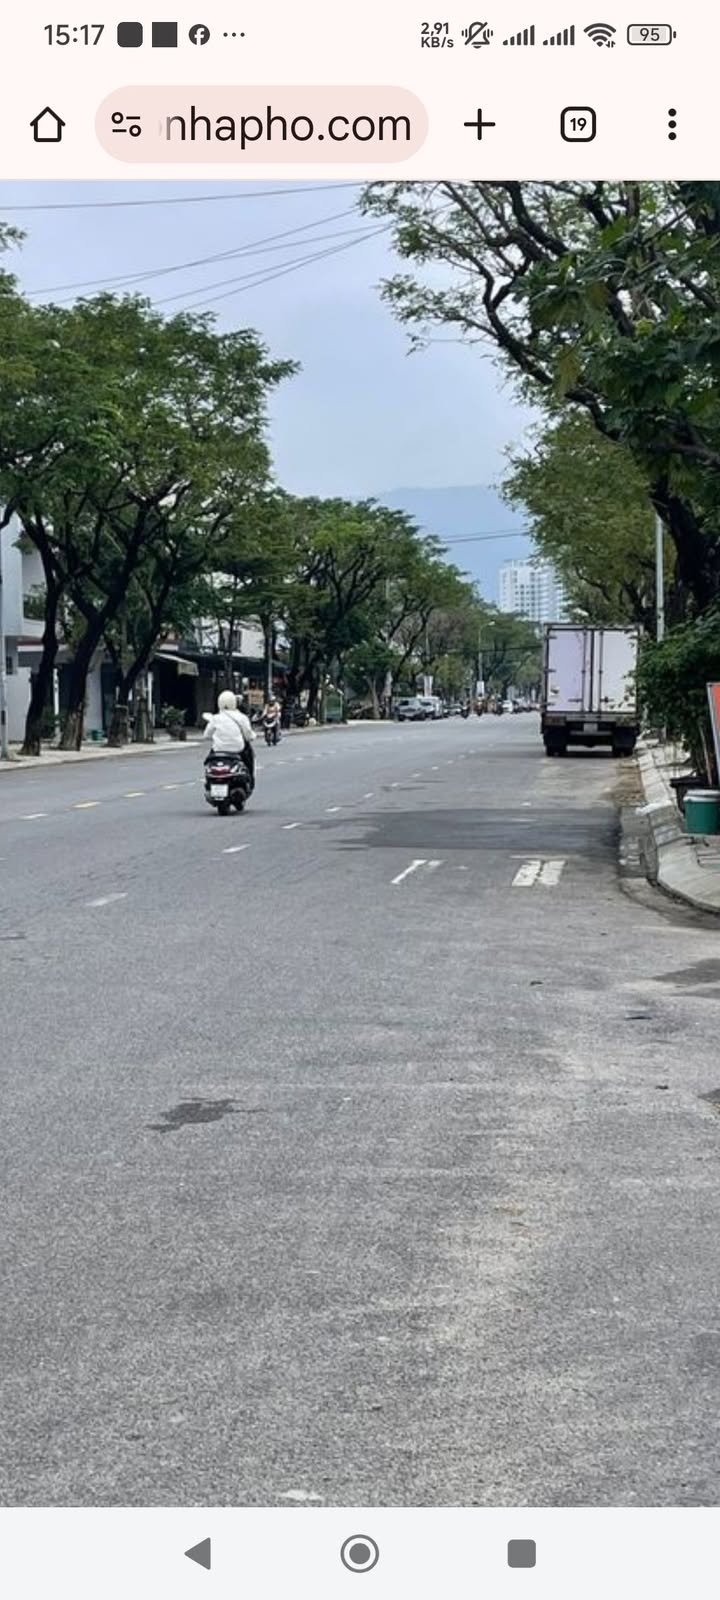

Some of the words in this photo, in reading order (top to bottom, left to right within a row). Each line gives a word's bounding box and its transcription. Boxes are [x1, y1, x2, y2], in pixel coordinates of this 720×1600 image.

[43, 25, 105, 46] 15:17
[420, 21, 449, 36] 2,91
[640, 28, 660, 42] 95
[420, 36, 455, 48] KB/s
[159, 105, 411, 150] nhapho.com
[570, 118, 587, 131] 19
